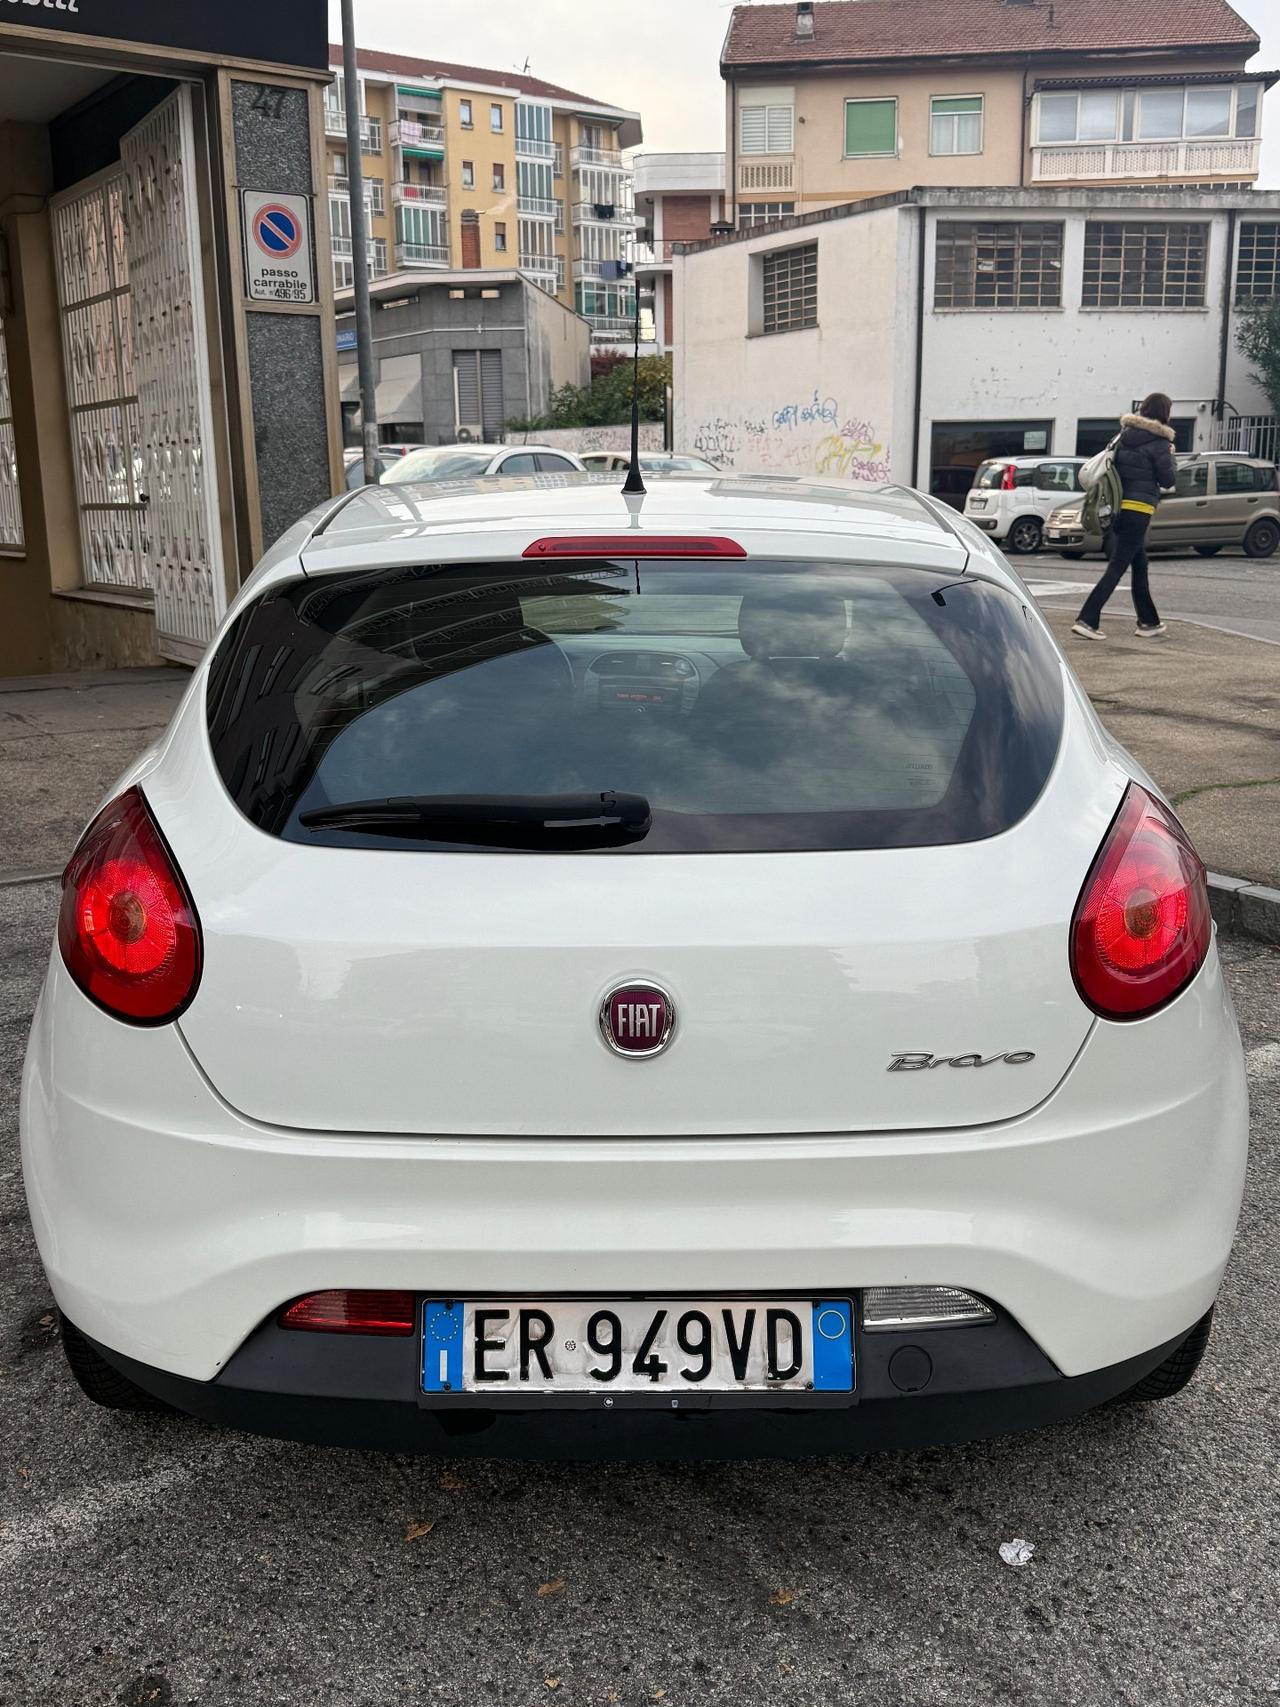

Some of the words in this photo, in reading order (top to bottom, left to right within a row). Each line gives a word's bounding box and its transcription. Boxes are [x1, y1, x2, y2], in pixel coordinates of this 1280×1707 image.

[252, 87, 286, 119] 47
[253, 279, 308, 290] carrabile
[261, 268, 298, 278] passo
[617, 1004, 661, 1037] FIAT
[887, 1050, 1036, 1072] Bravo
[474, 1308, 555, 1381] ER
[587, 1308, 802, 1382] 949VD
